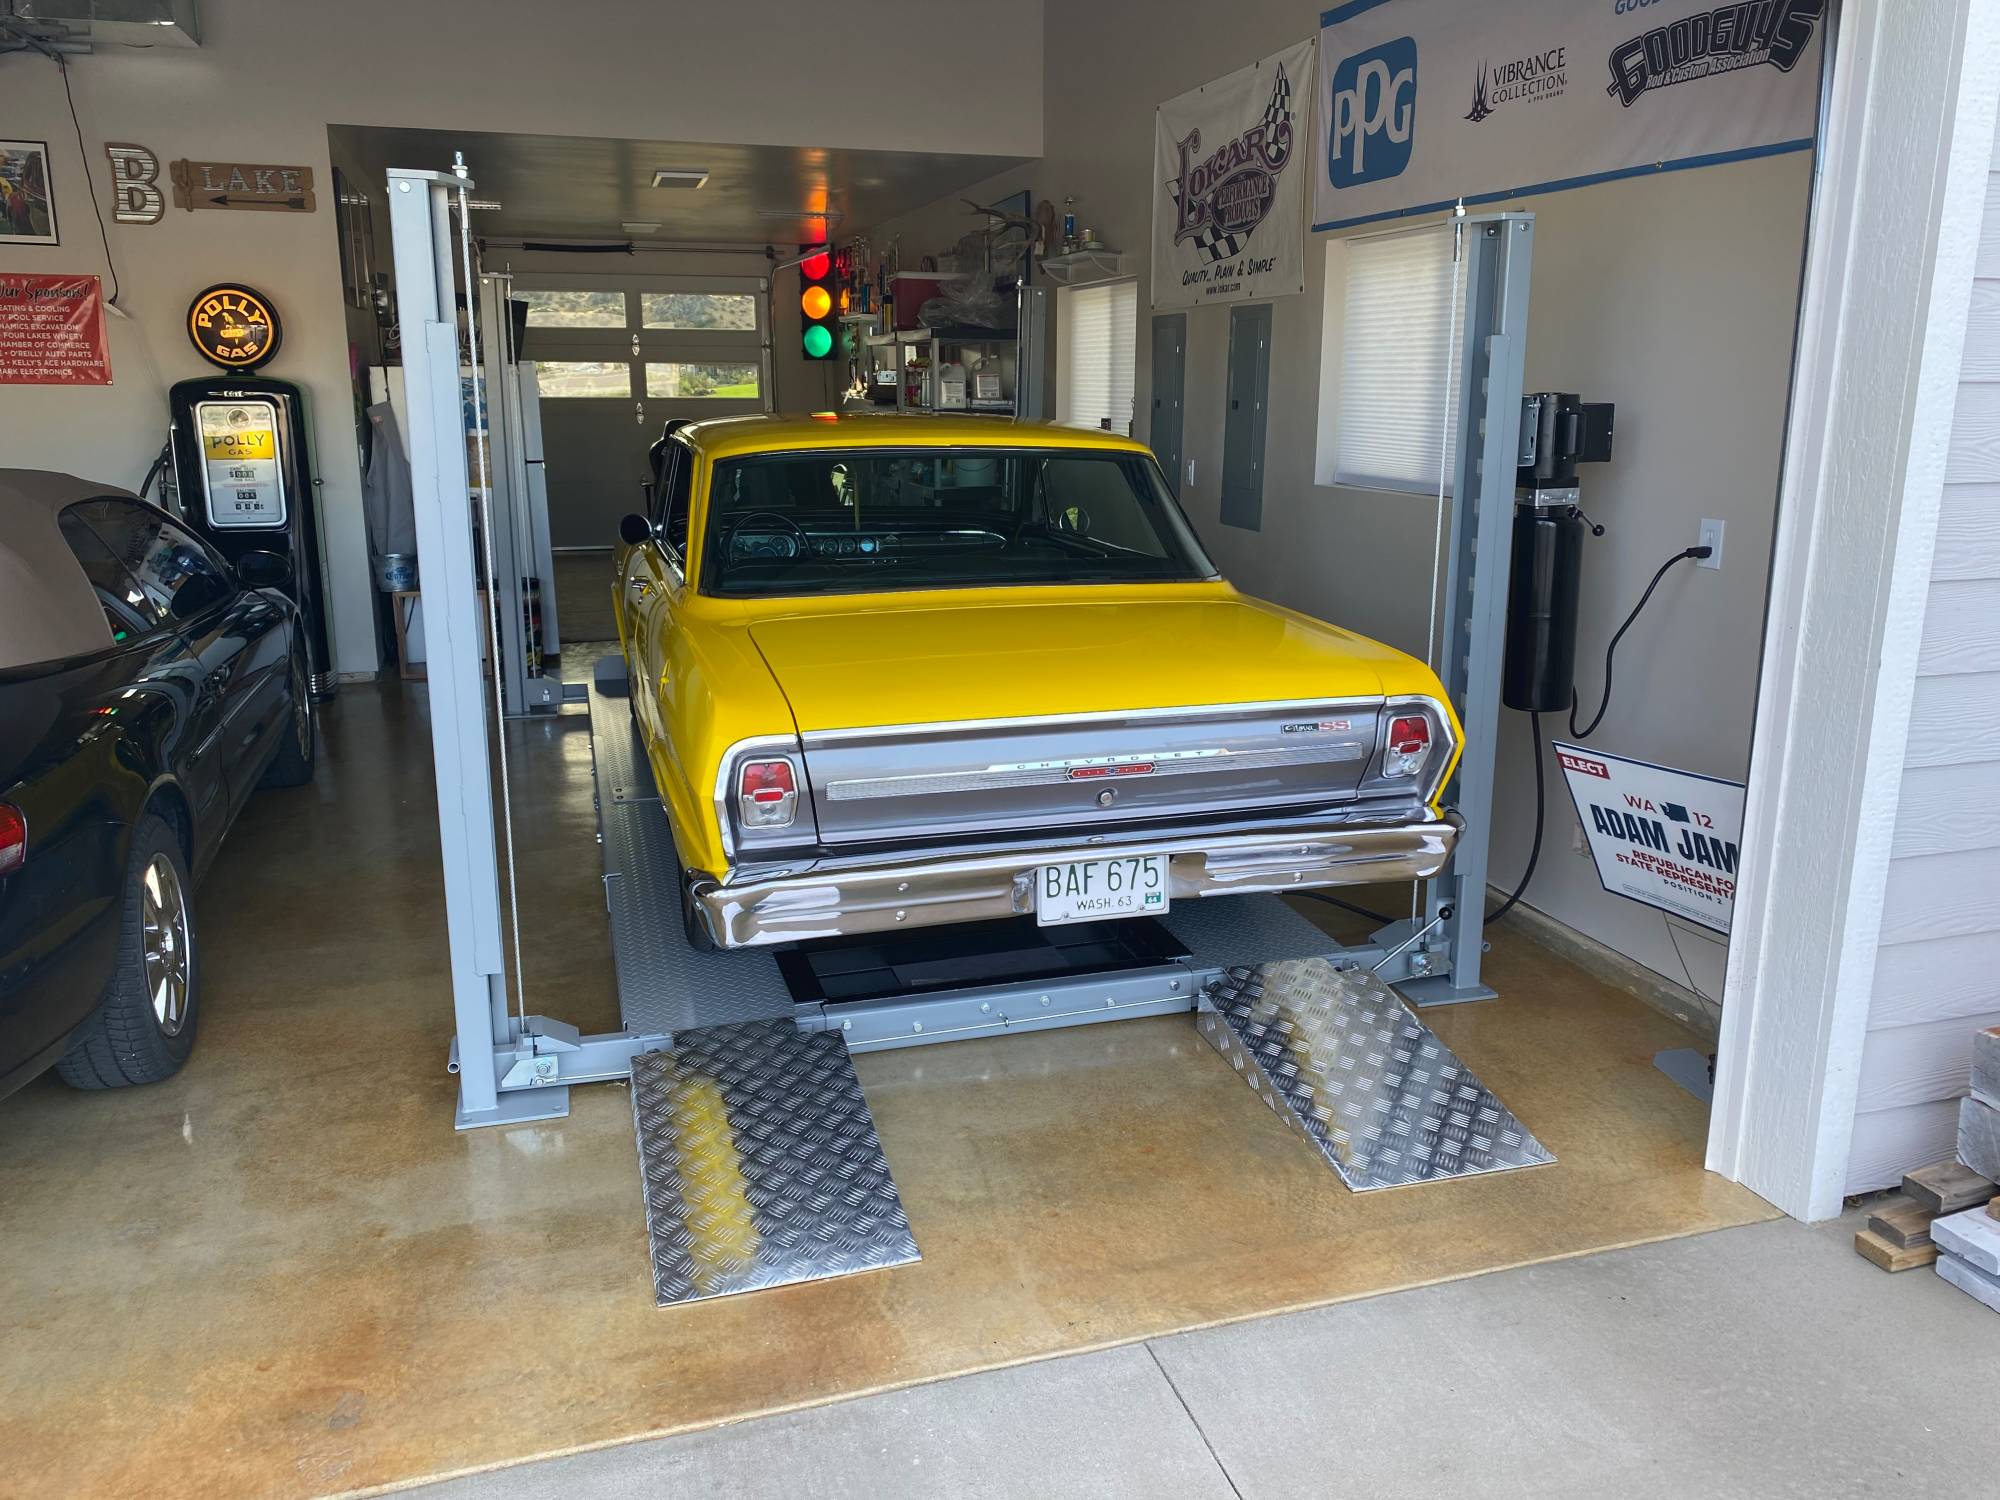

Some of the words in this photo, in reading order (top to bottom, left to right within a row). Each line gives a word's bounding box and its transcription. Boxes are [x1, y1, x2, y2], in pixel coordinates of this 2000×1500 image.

[1615, 0, 1664, 15] GOO
[1607, 0, 1823, 107] GOODGUYS
[1493, 47, 1566, 86] VIBRANCE
[1645, 72, 1664, 88] Rod
[1671, 63, 1708, 82] Custom
[1709, 49, 1770, 73] Association
[1492, 72, 1566, 104] COLLECTION
[1333, 59, 1413, 174] PPG
[104, 142, 165, 225] B
[200, 166, 302, 194] LAKE
[35, 305, 70, 313] COOLING
[198, 295, 266, 328] POLLY
[31, 323, 79, 331] EXCAVATION
[47, 341, 91, 349] COMMERCE
[216, 341, 259, 358] GAS
[20, 368, 73, 376] ELECTRONICS
[211, 434, 265, 448] POLLY
[228, 448, 253, 456] GAS
[1017, 751, 1203, 769] CHEVROLET
[1562, 756, 1605, 775] ELECT
[1623, 793, 1657, 814] WA
[1692, 811, 1714, 829] 12
[1590, 803, 1671, 853] ADAM
[1677, 828, 1738, 874] JAM
[1616, 853, 1653, 872] STATE
[1632, 850, 1713, 883] REPUBLICAN
[1716, 876, 1735, 891] FO
[1046, 862, 1098, 898] BAF
[1108, 857, 1158, 891] 675
[1118, 895, 1132, 906] 63
[1663, 879, 1712, 901] POSITION
